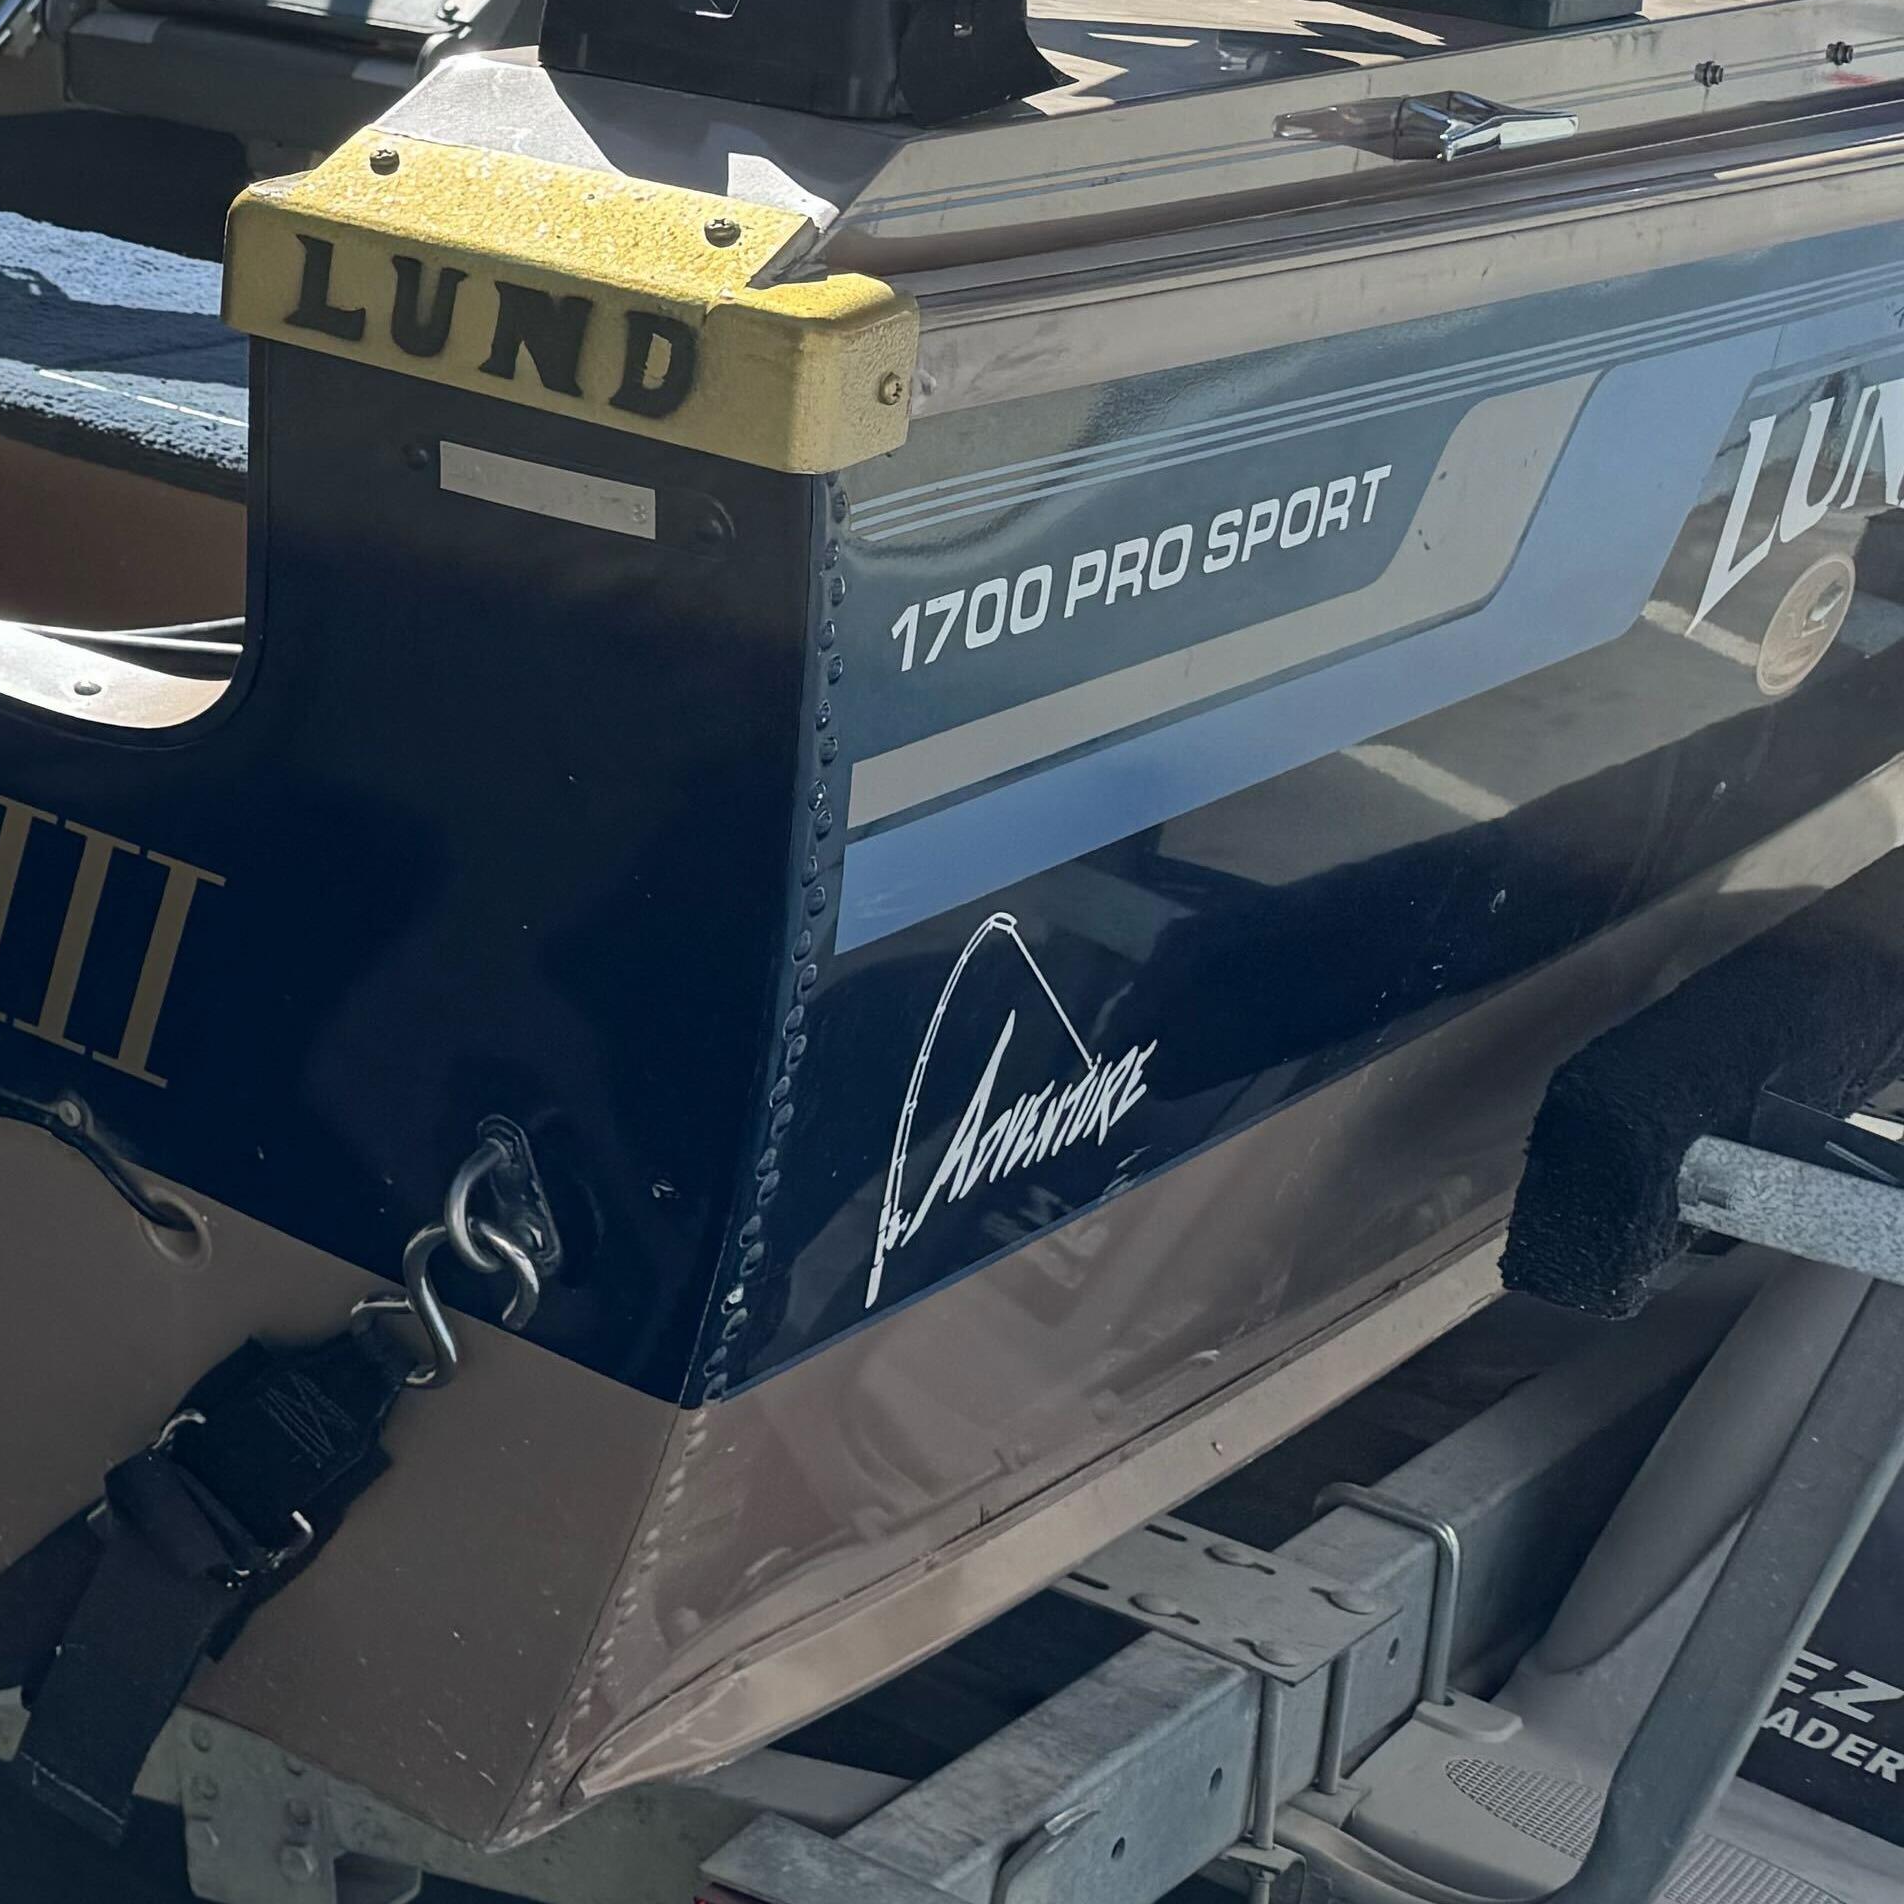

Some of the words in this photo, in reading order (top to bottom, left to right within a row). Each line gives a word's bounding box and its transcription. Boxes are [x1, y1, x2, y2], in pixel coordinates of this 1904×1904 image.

[284, 233, 699, 419] LUND
[891, 563, 1053, 672] 1700
[1064, 523, 1193, 619] PRO
[1203, 464, 1393, 574] SPORT
